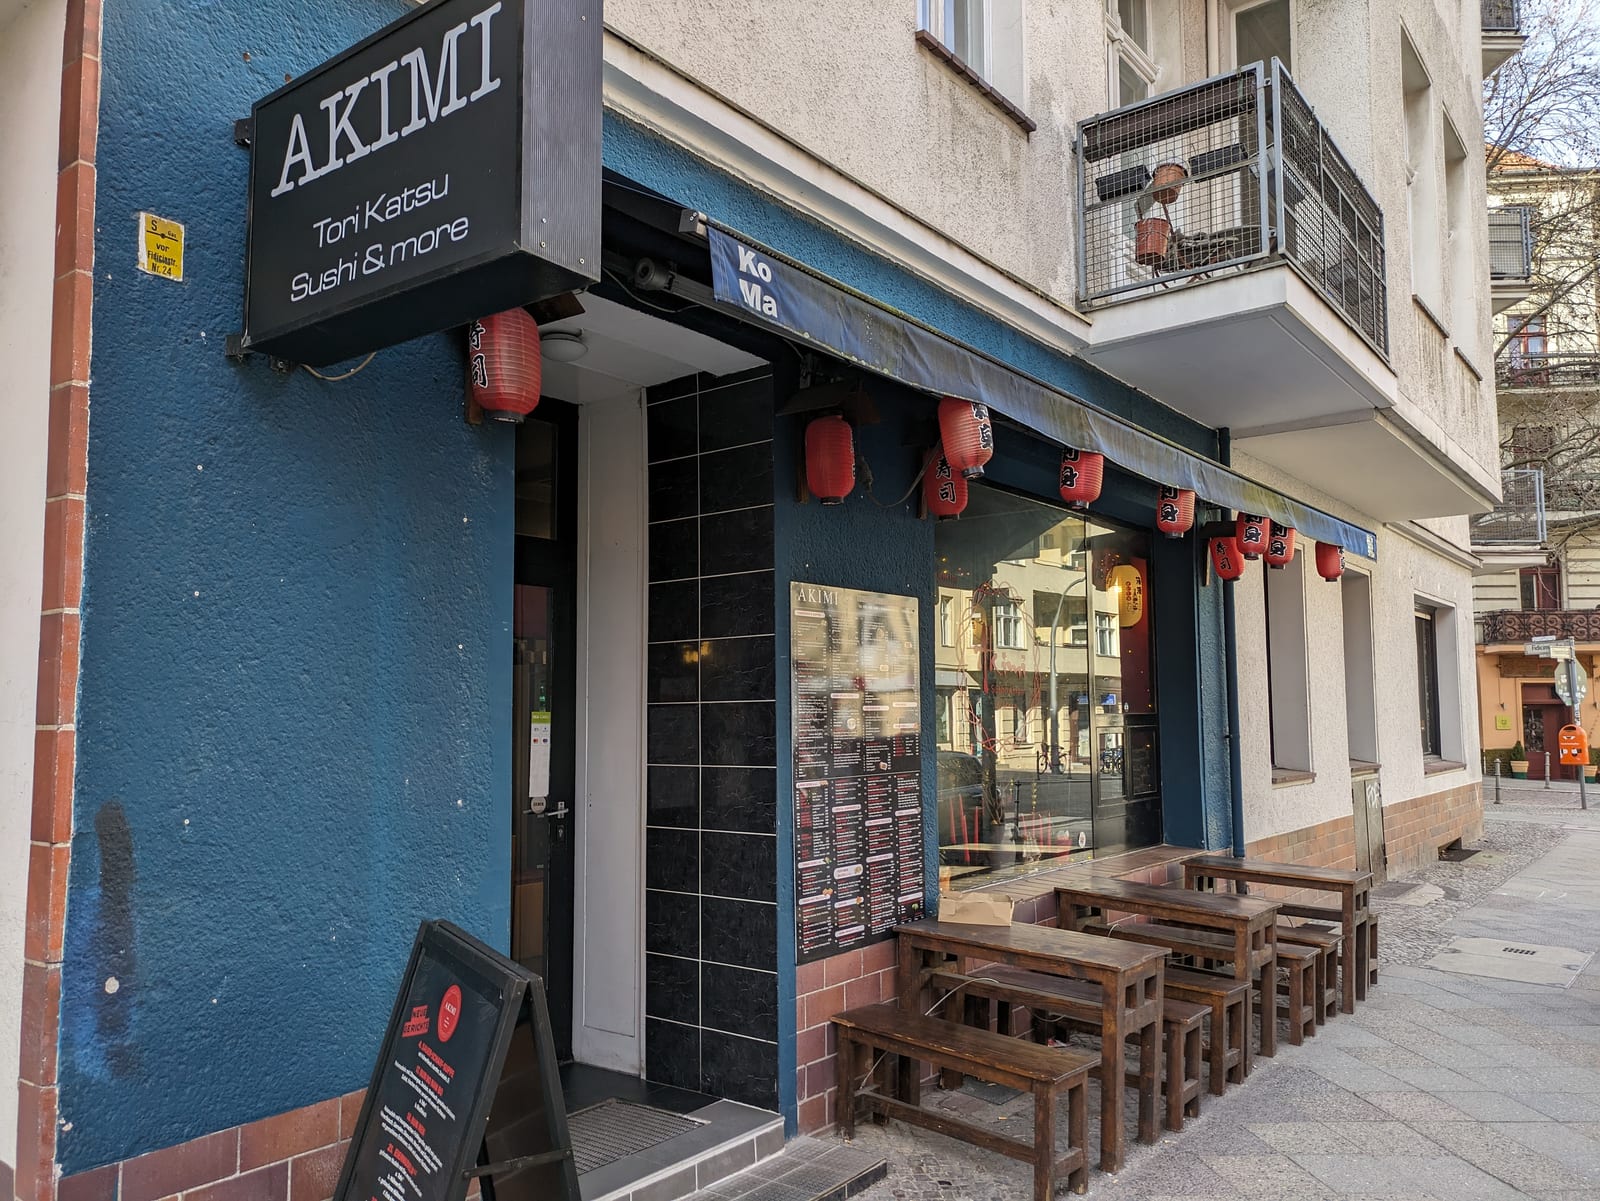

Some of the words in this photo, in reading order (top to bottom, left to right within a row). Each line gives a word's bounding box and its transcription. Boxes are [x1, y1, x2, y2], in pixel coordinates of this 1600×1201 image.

[270, 2, 502, 198] AKIMI
[151, 220, 158, 231] S
[313, 205, 360, 248] Tori
[364, 173, 449, 230] Katsu
[156, 243, 170, 252] vor
[290, 251, 359, 302] Sushi
[362, 244, 386, 275] &
[389, 217, 470, 266] more
[737, 245, 772, 283] Ko
[162, 265, 172, 276] 24
[738, 278, 778, 318] Ma
[797, 588, 839, 606] AKIMI
